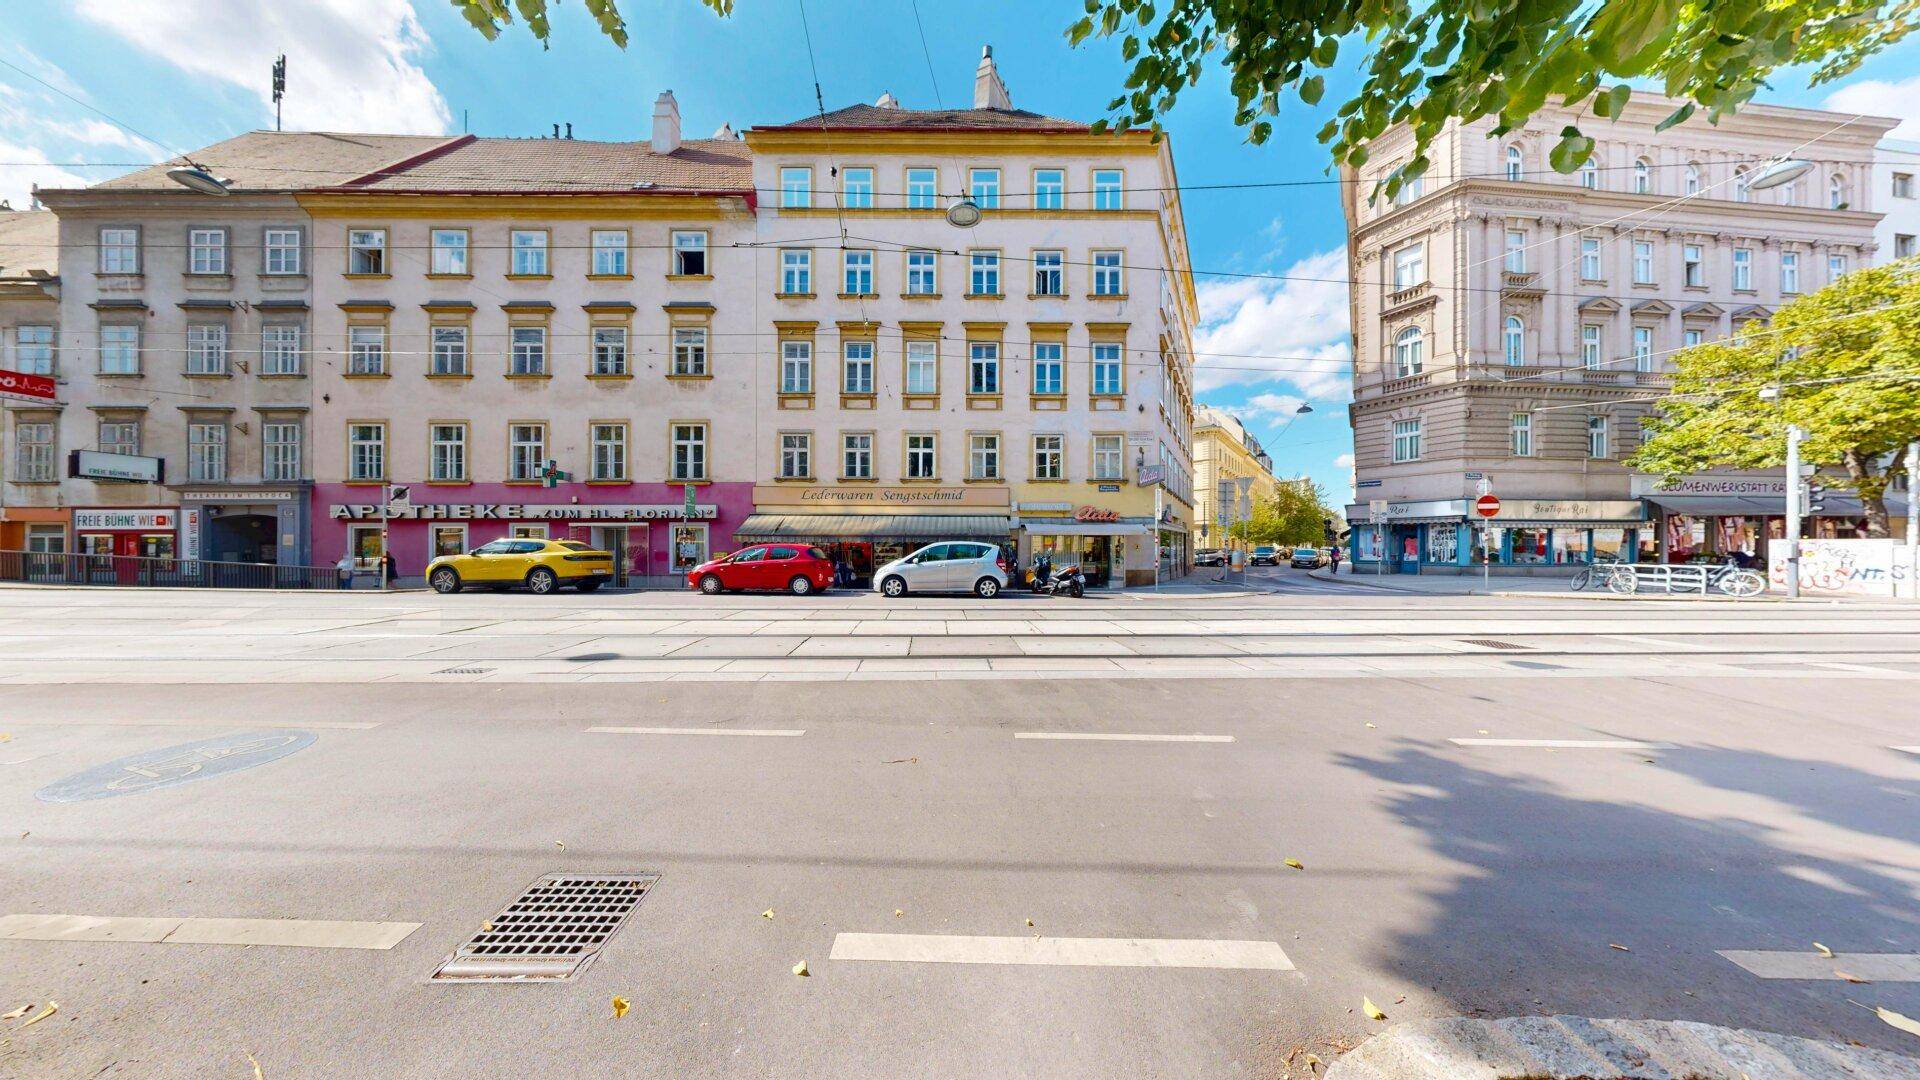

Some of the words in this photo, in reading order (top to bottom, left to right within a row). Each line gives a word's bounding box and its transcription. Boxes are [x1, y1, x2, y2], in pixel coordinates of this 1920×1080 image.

[801, 489, 874, 500] Lederwaren
[880, 488, 966, 503] Sengstschmid
[77, 515, 102, 526] FREIE
[105, 513, 136, 526] BÜHNE
